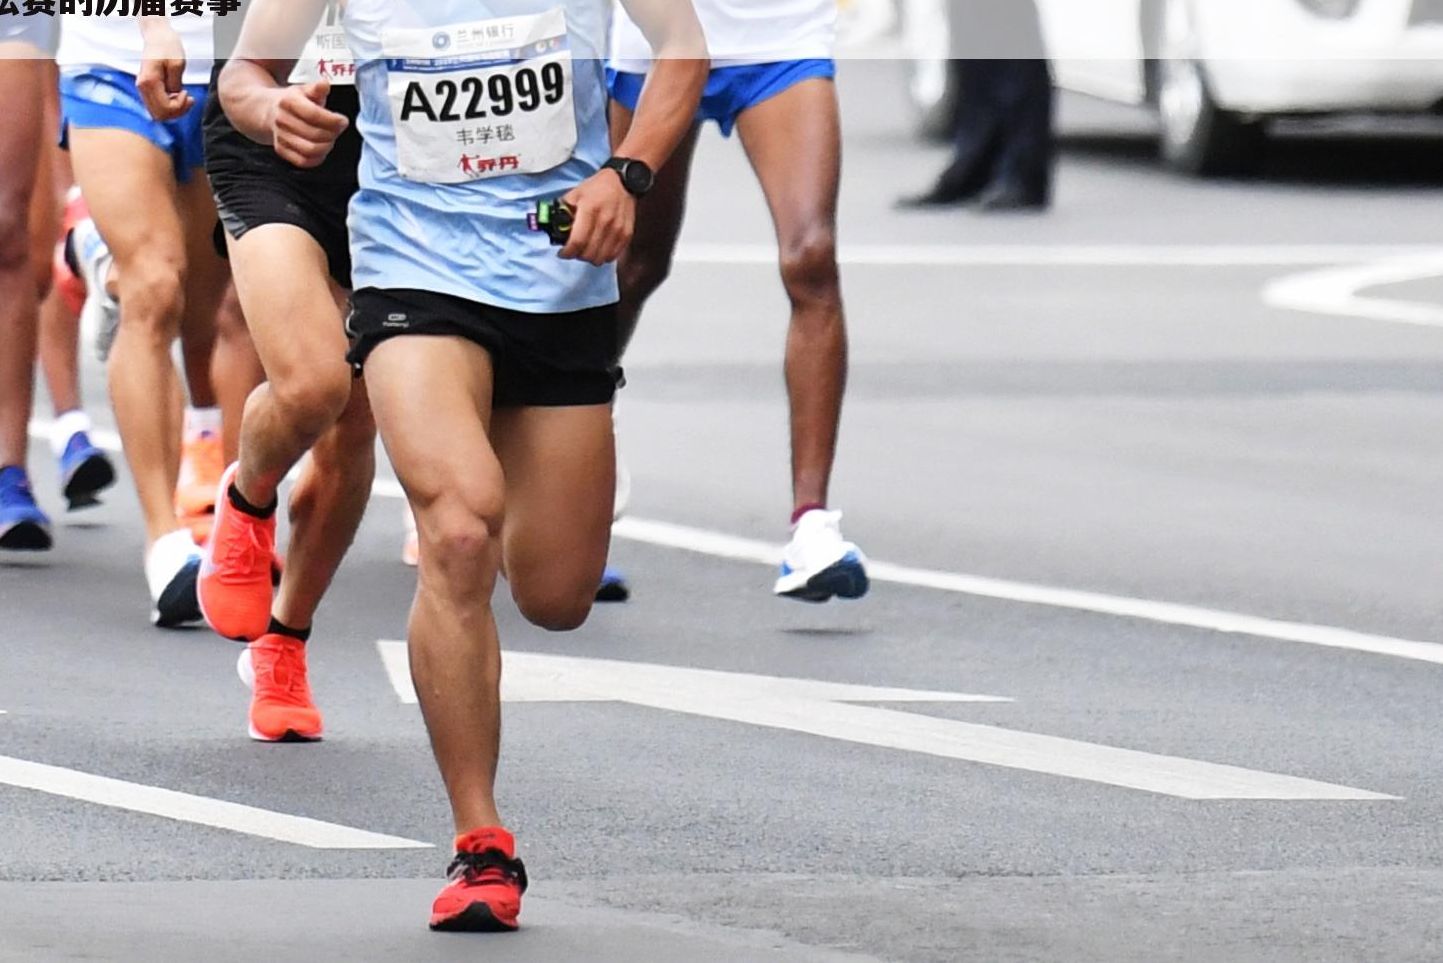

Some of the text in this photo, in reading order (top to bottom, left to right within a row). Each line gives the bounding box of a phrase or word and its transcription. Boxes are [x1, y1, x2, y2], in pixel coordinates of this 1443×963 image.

[456, 23, 515, 44] 兰州银行
[400, 61, 565, 123] A22999
